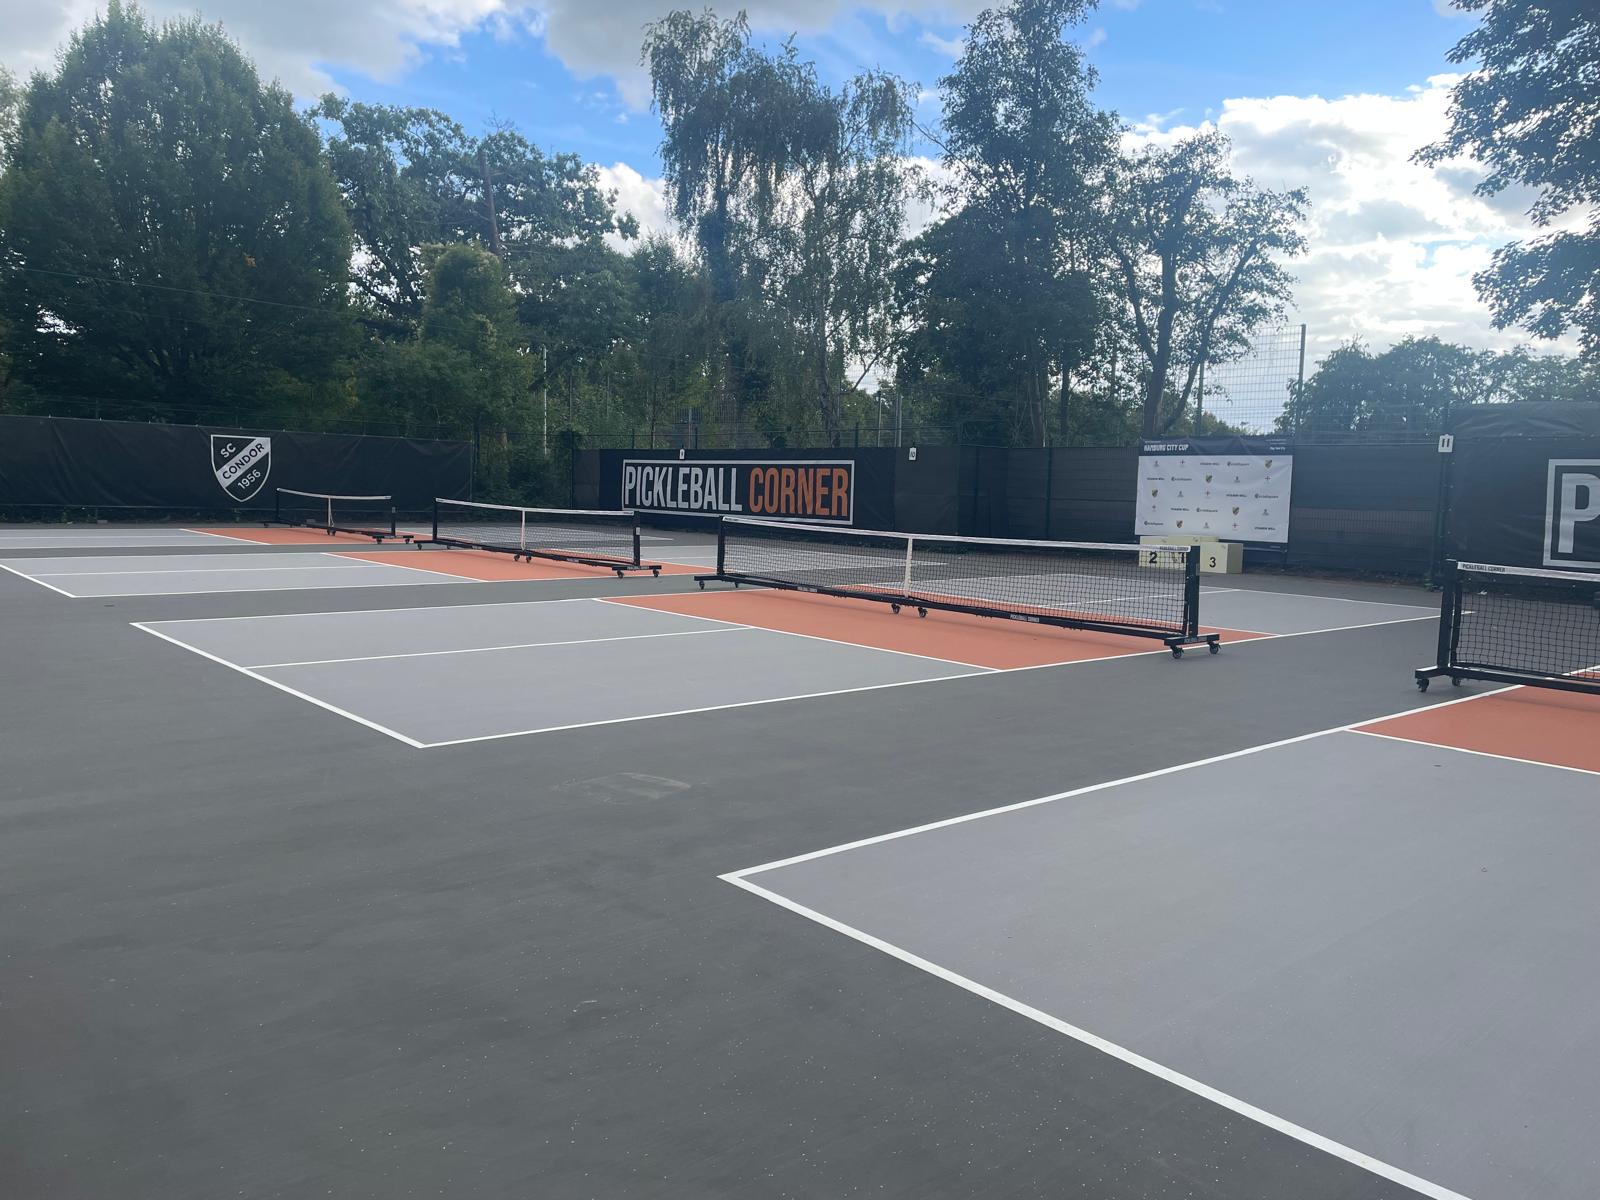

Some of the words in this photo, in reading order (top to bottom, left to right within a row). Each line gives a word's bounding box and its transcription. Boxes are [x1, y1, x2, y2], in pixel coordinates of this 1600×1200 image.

[220, 443, 236, 458] SC
[1442, 439, 1450, 448] 11
[222, 443, 265, 480] CONDOR
[237, 469, 261, 490] 1956
[624, 466, 743, 512] PICKLEBALL
[750, 467, 849, 517] CORNER
[1558, 473, 1600, 553] P
[1149, 551, 1158, 564] 2
[1178, 552, 1185, 564] 1
[1209, 557, 1217, 568] 3
